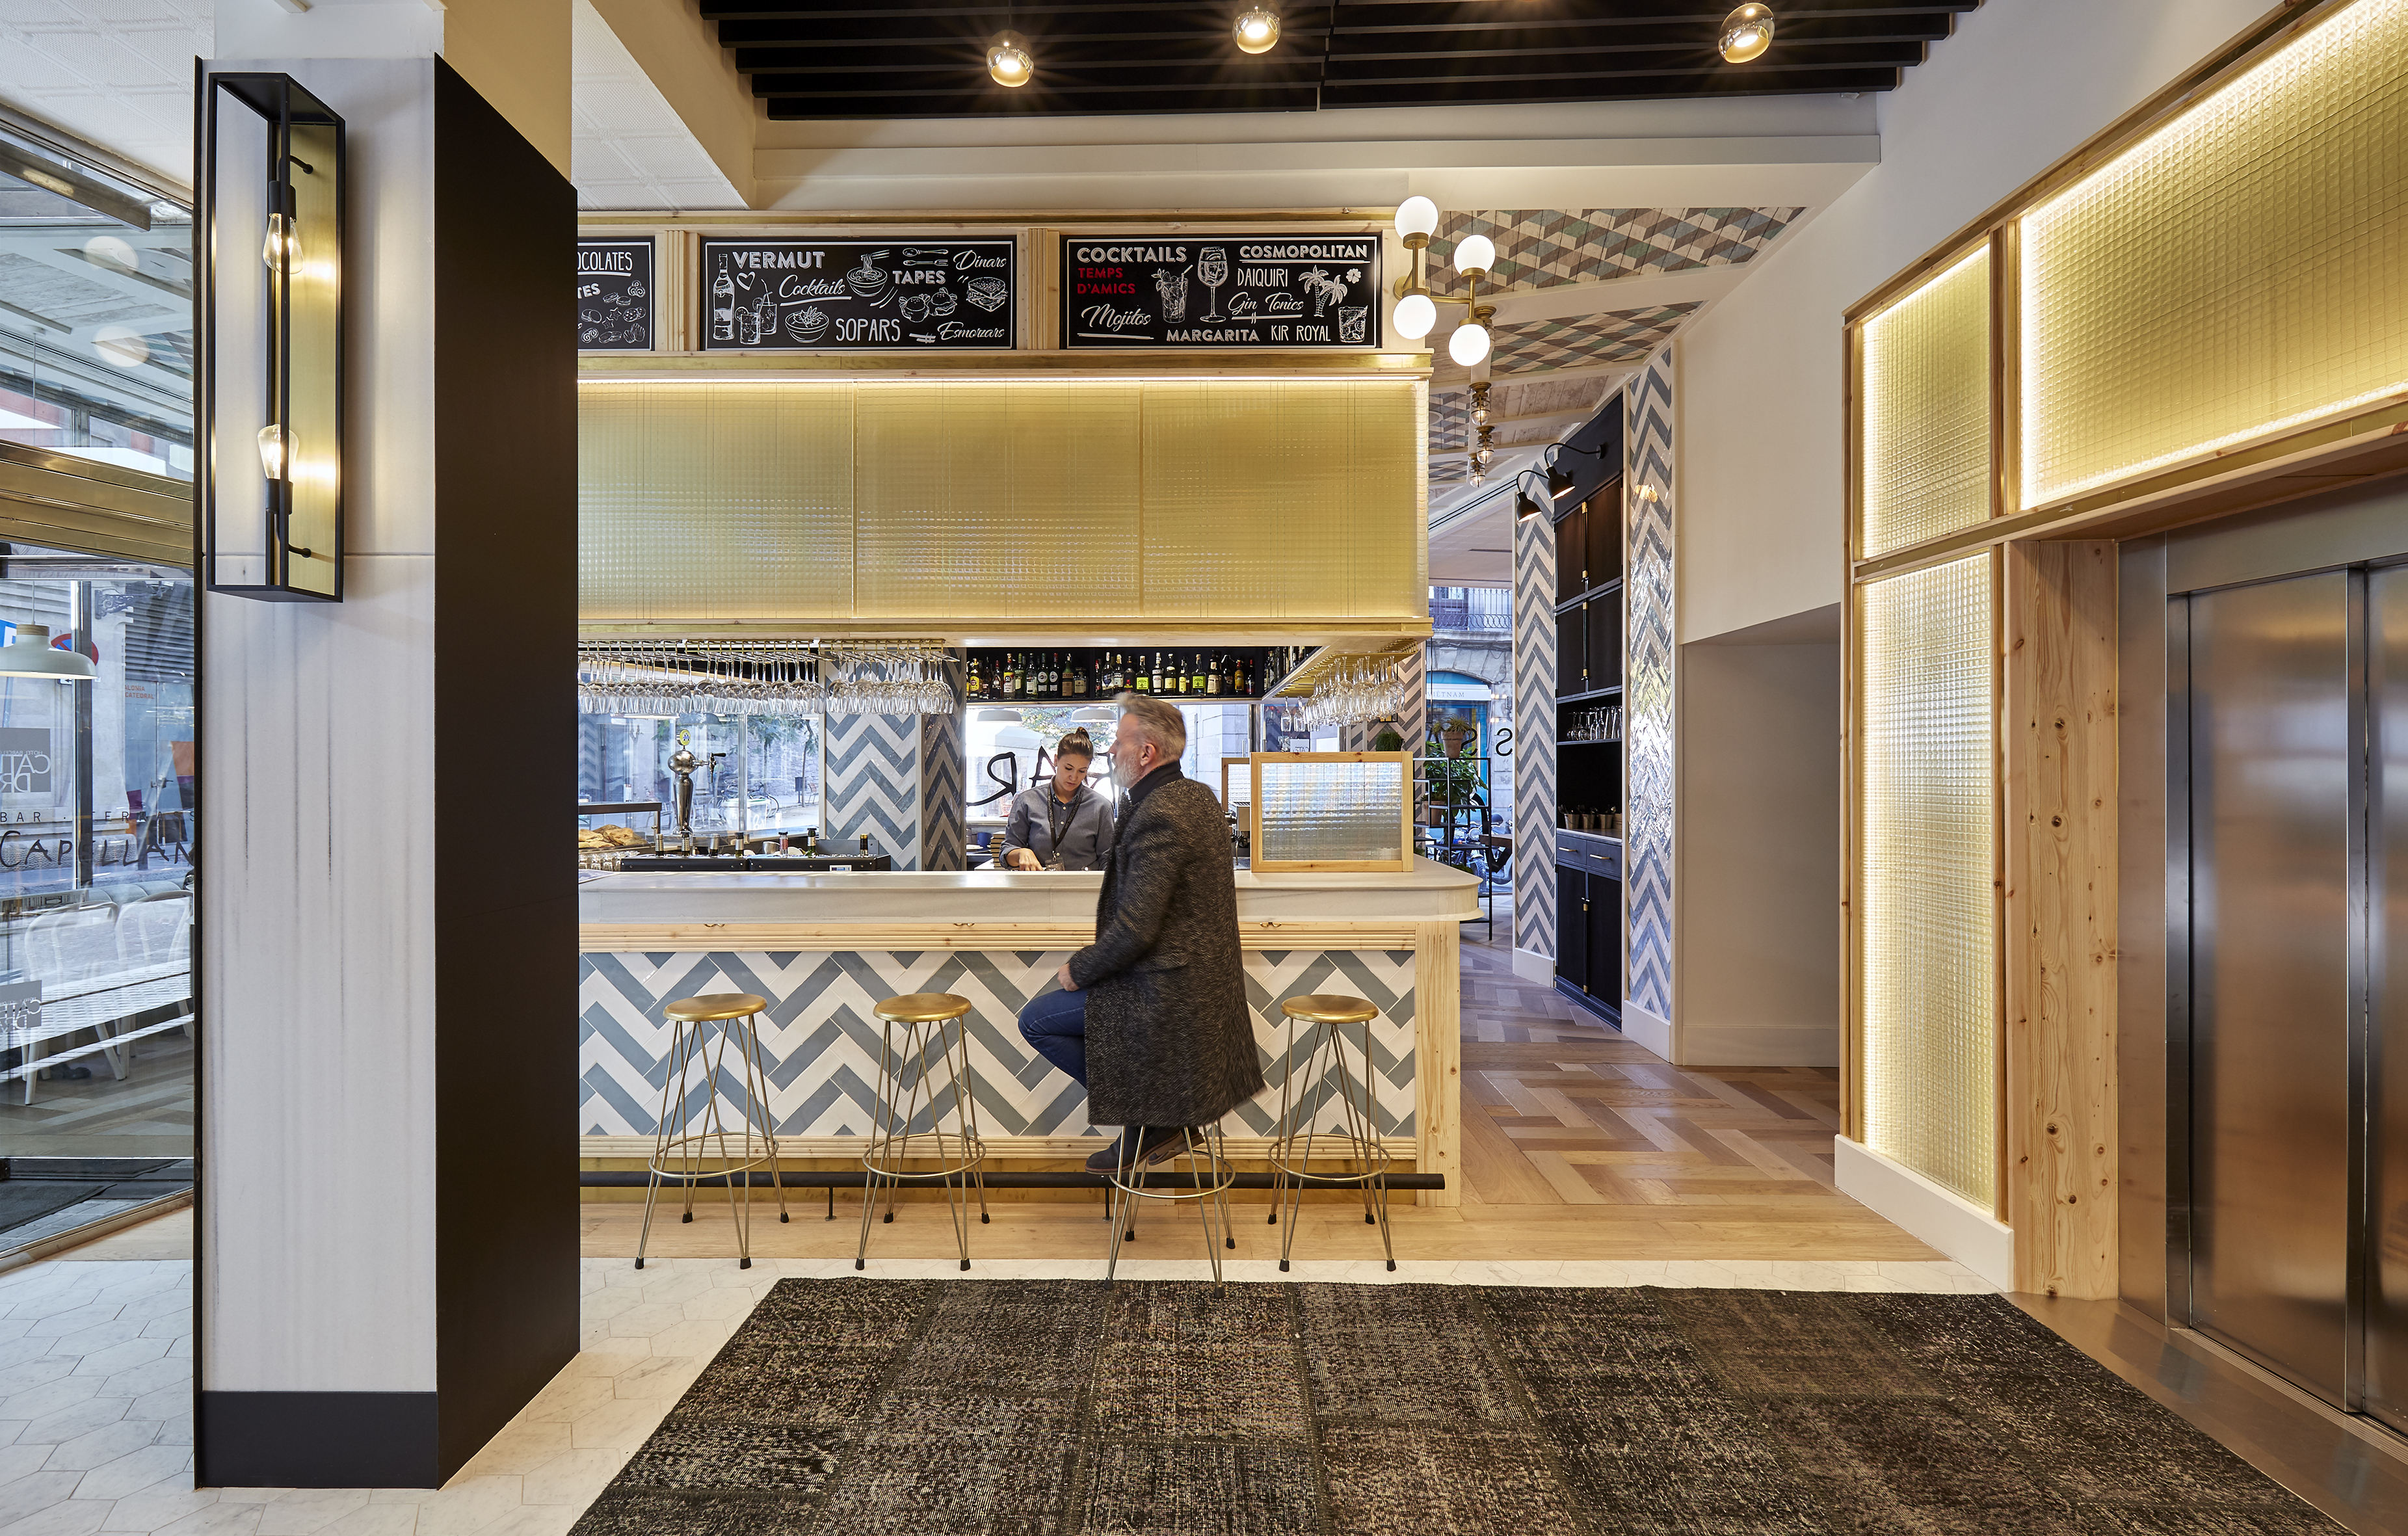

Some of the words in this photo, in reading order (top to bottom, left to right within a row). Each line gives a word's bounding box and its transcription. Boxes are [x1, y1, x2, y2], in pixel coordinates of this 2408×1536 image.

[732, 251, 825, 269] VERMUT
[953, 250, 1007, 271] Dinars
[1077, 246, 1187, 263] COCKTAILS
[1239, 245, 1368, 259] COSMOPOLITAN
[892, 271, 946, 284] TAPES
[1078, 267, 1124, 279] TEMPS
[1237, 267, 1288, 287] DAIQUIRI
[778, 274, 846, 298] Cocktails
[1228, 292, 1258, 315] Gin
[1265, 293, 1304, 311] Tonics
[1081, 304, 1152, 332] Mojitos
[835, 318, 901, 342] SOPARS
[937, 321, 1005, 341] Esmorzars
[1167, 329, 1260, 342] MARGARITA
[1271, 325, 1290, 342] KIR
[1296, 325, 1331, 342] ROYAL
[0, 812, 41, 822] BAR
